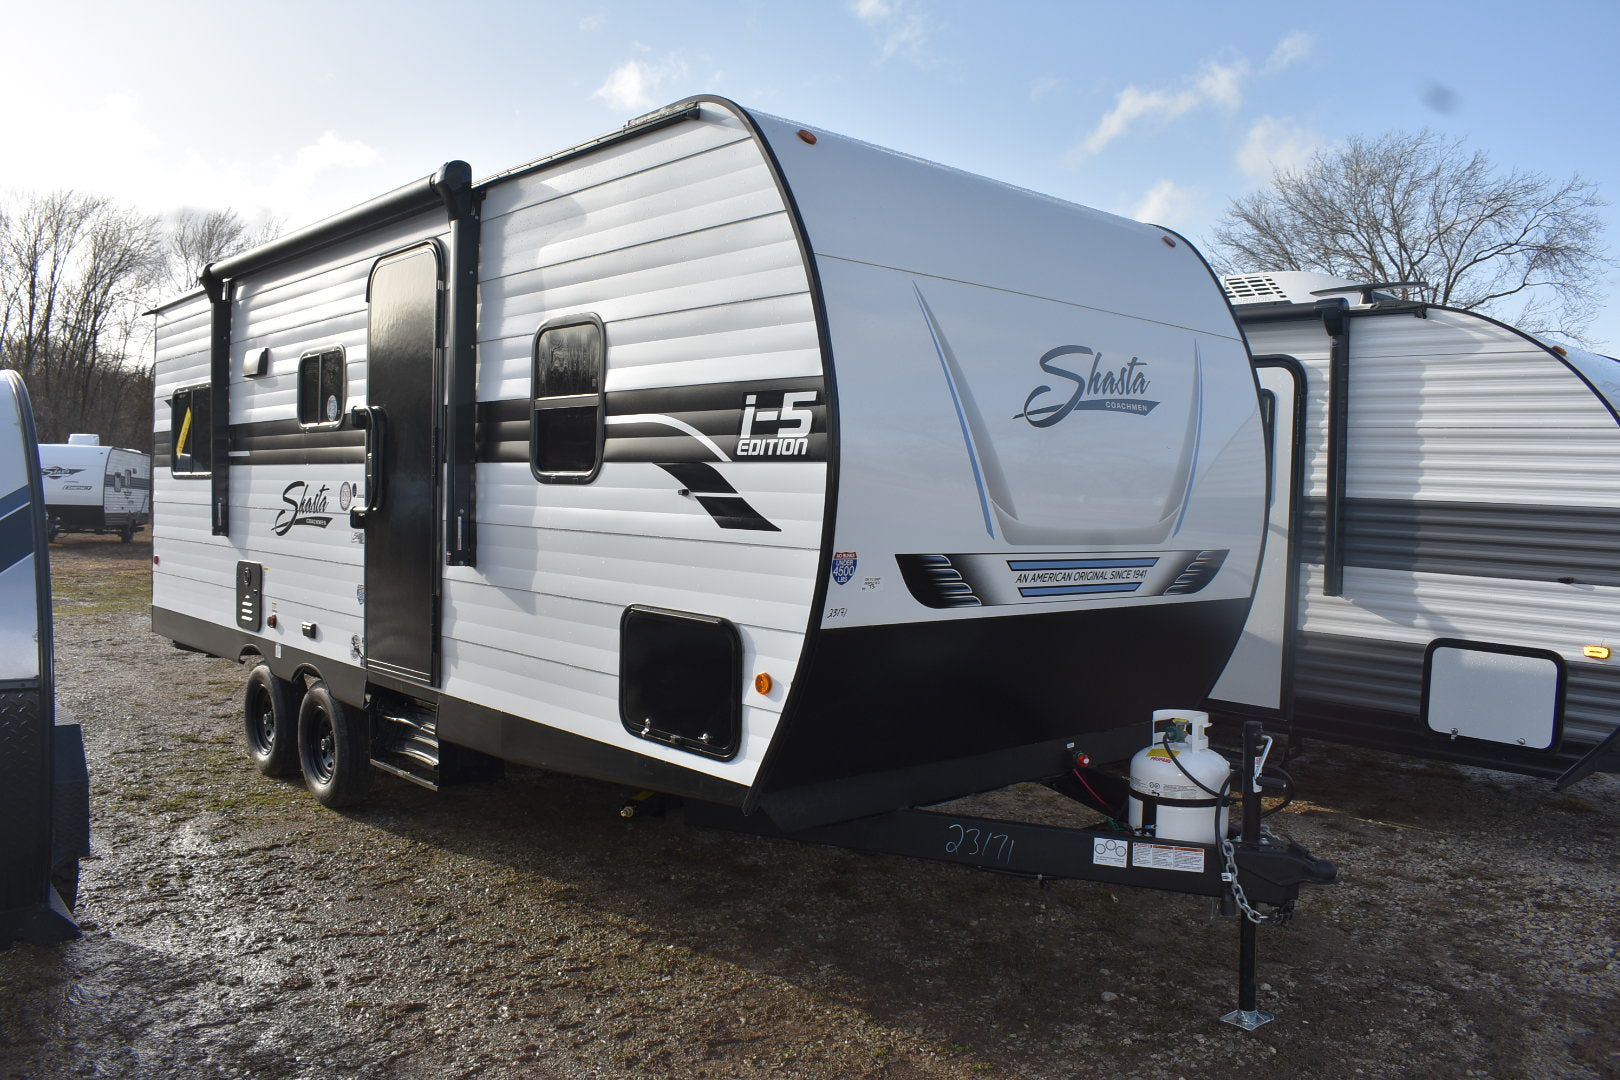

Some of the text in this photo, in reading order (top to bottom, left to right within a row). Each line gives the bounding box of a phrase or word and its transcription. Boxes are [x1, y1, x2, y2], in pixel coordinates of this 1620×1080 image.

[1023, 344, 1151, 429] Shasta
[1105, 400, 1148, 412] COACHMEN
[736, 438, 808, 456] EDITION
[274, 480, 330, 537] Shasta
[833, 566, 854, 576] 4500
[1015, 569, 1148, 583] AN AMERICAN ORIGINAL SINCE 1941
[945, 823, 1014, 864] 23171
